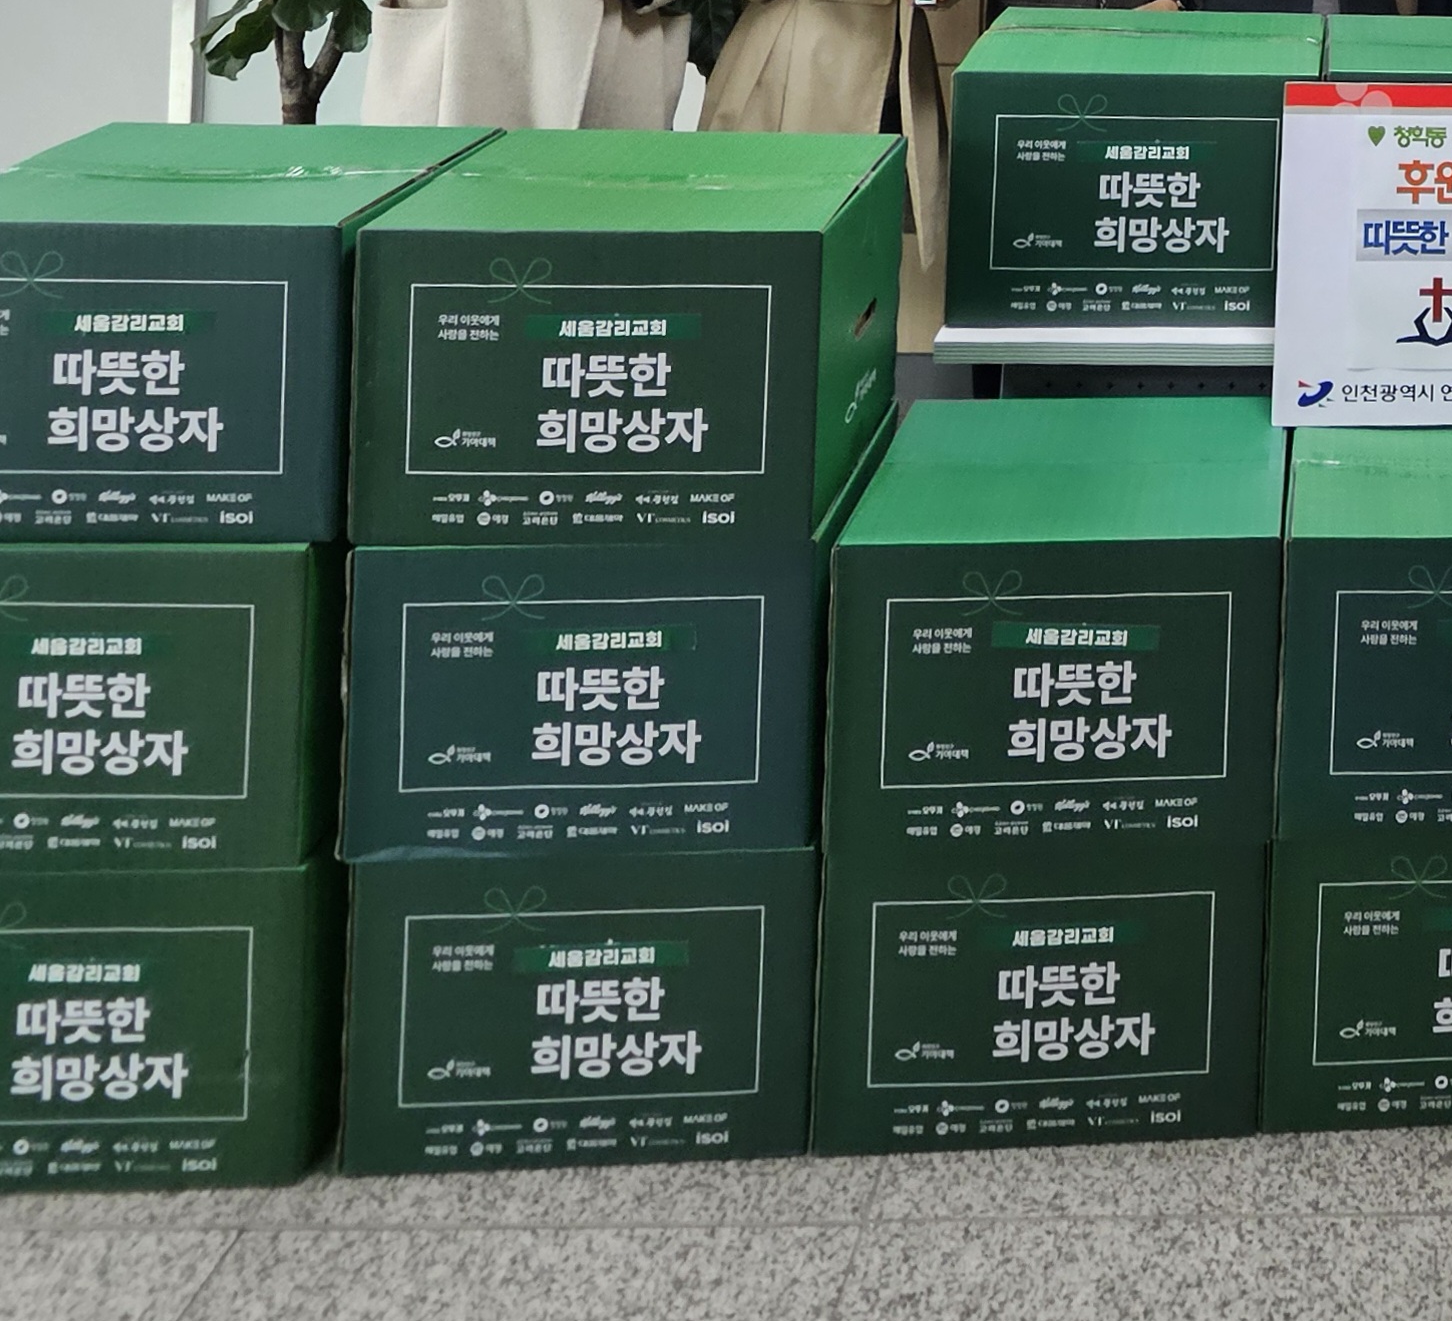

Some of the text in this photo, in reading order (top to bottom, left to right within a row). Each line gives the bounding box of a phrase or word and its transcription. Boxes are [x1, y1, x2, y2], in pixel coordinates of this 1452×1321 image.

[1393, 125, 1447, 148] 청학동
[1100, 172, 1201, 207] 따뜻한
[1094, 217, 1229, 253] 희망상자
[1363, 220, 1448, 255] 따뜻한
[438, 314, 500, 326] 우리 이웃에게
[438, 329, 499, 341] 사랑을 전하는
[53, 349, 185, 395] 따뜻한
[543, 353, 671, 397] 따뜻한
[1341, 381, 1436, 403] 인천광역시
[48, 407, 224, 452] 희망상자
[537, 408, 708, 453] 희망상자
[690, 494, 718, 502] MAKE
[703, 511, 734, 523] isoi
[913, 627, 972, 640] 우리 이웃에게
[913, 642, 971, 654] 사랑을 전하는
[1361, 620, 1418, 632] 우리 이웃에게
[1361, 634, 1417, 646] 사랑을 전하는
[18, 672, 151, 718] 따뜻한
[537, 666, 665, 711] 따뜻한
[1014, 661, 1137, 707] 따뜻한
[12, 729, 188, 776] 희망상자
[532, 720, 701, 766] 희망상자
[1008, 714, 1172, 762] 희망상자
[1167, 815, 1198, 828] isoi
[537, 977, 665, 1024] 따뜻한
[998, 961, 1120, 1008] 따뜻한
[16, 997, 150, 1044] 따뜻한
[993, 1013, 1155, 1062] 희망상자
[11, 1053, 189, 1101] 희망상자
[531, 1031, 702, 1079] 희망상자
